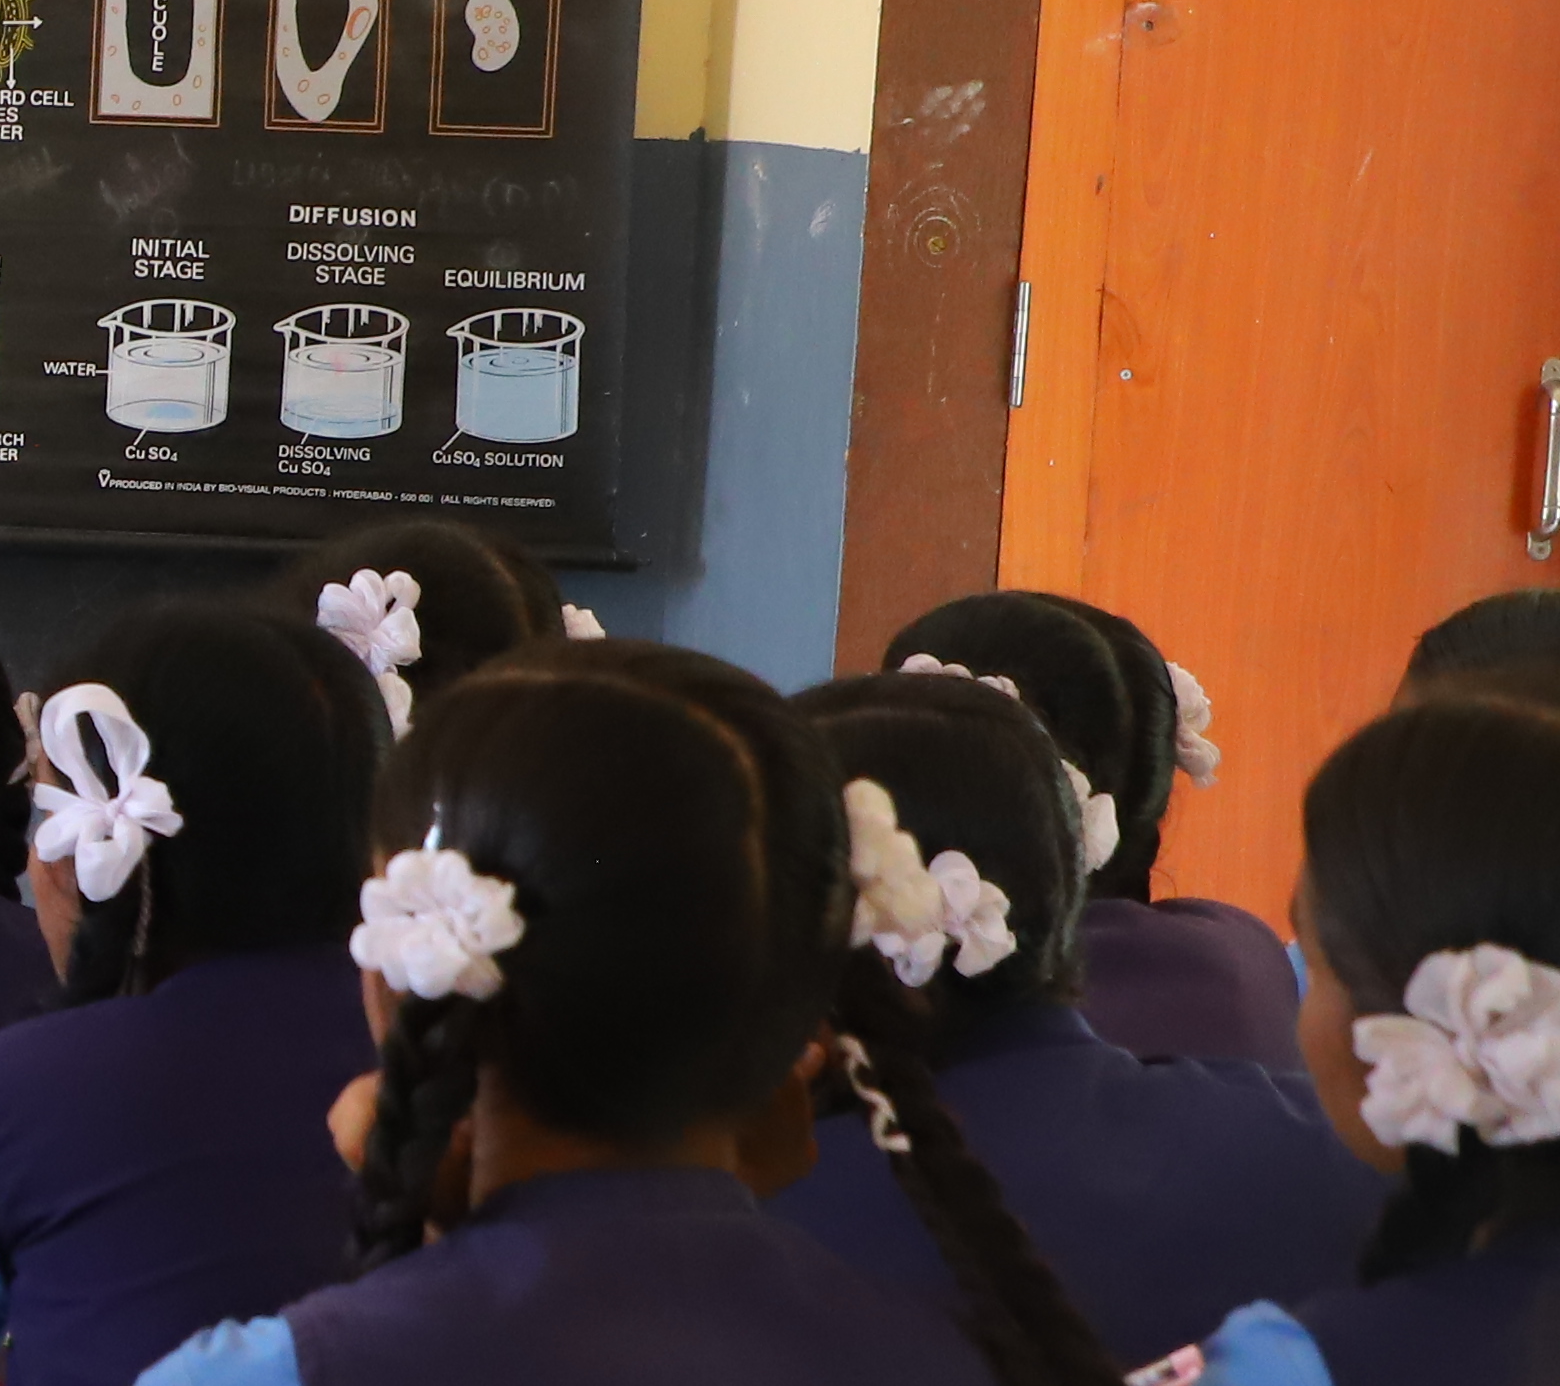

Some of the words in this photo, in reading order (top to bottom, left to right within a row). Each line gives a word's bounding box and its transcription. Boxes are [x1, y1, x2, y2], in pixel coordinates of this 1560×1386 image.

[30, 89, 75, 107] CELL
[288, 205, 417, 227] DIFFUSION
[130, 238, 210, 260] INITIAL
[286, 243, 416, 265] DISSOLVING
[133, 259, 206, 281] STAGE
[314, 265, 386, 286] STAGE
[443, 269, 586, 292] EQUILIBRIUM
[43, 362, 97, 377] WATER
[278, 445, 371, 462] DISSOLVING
[484, 452, 564, 469] SOLUTION
[109, 479, 162, 491] PRODUCED
[165, 482, 174, 490] IN
[176, 482, 201, 491] INDIA
[204, 483, 216, 492] BY
[219, 483, 271, 494] BIO-VISUAL
[273, 486, 326, 497] PRODUCTS
[333, 490, 392, 501] HYDERABAD
[463, 496, 499, 506] RIGHTS
